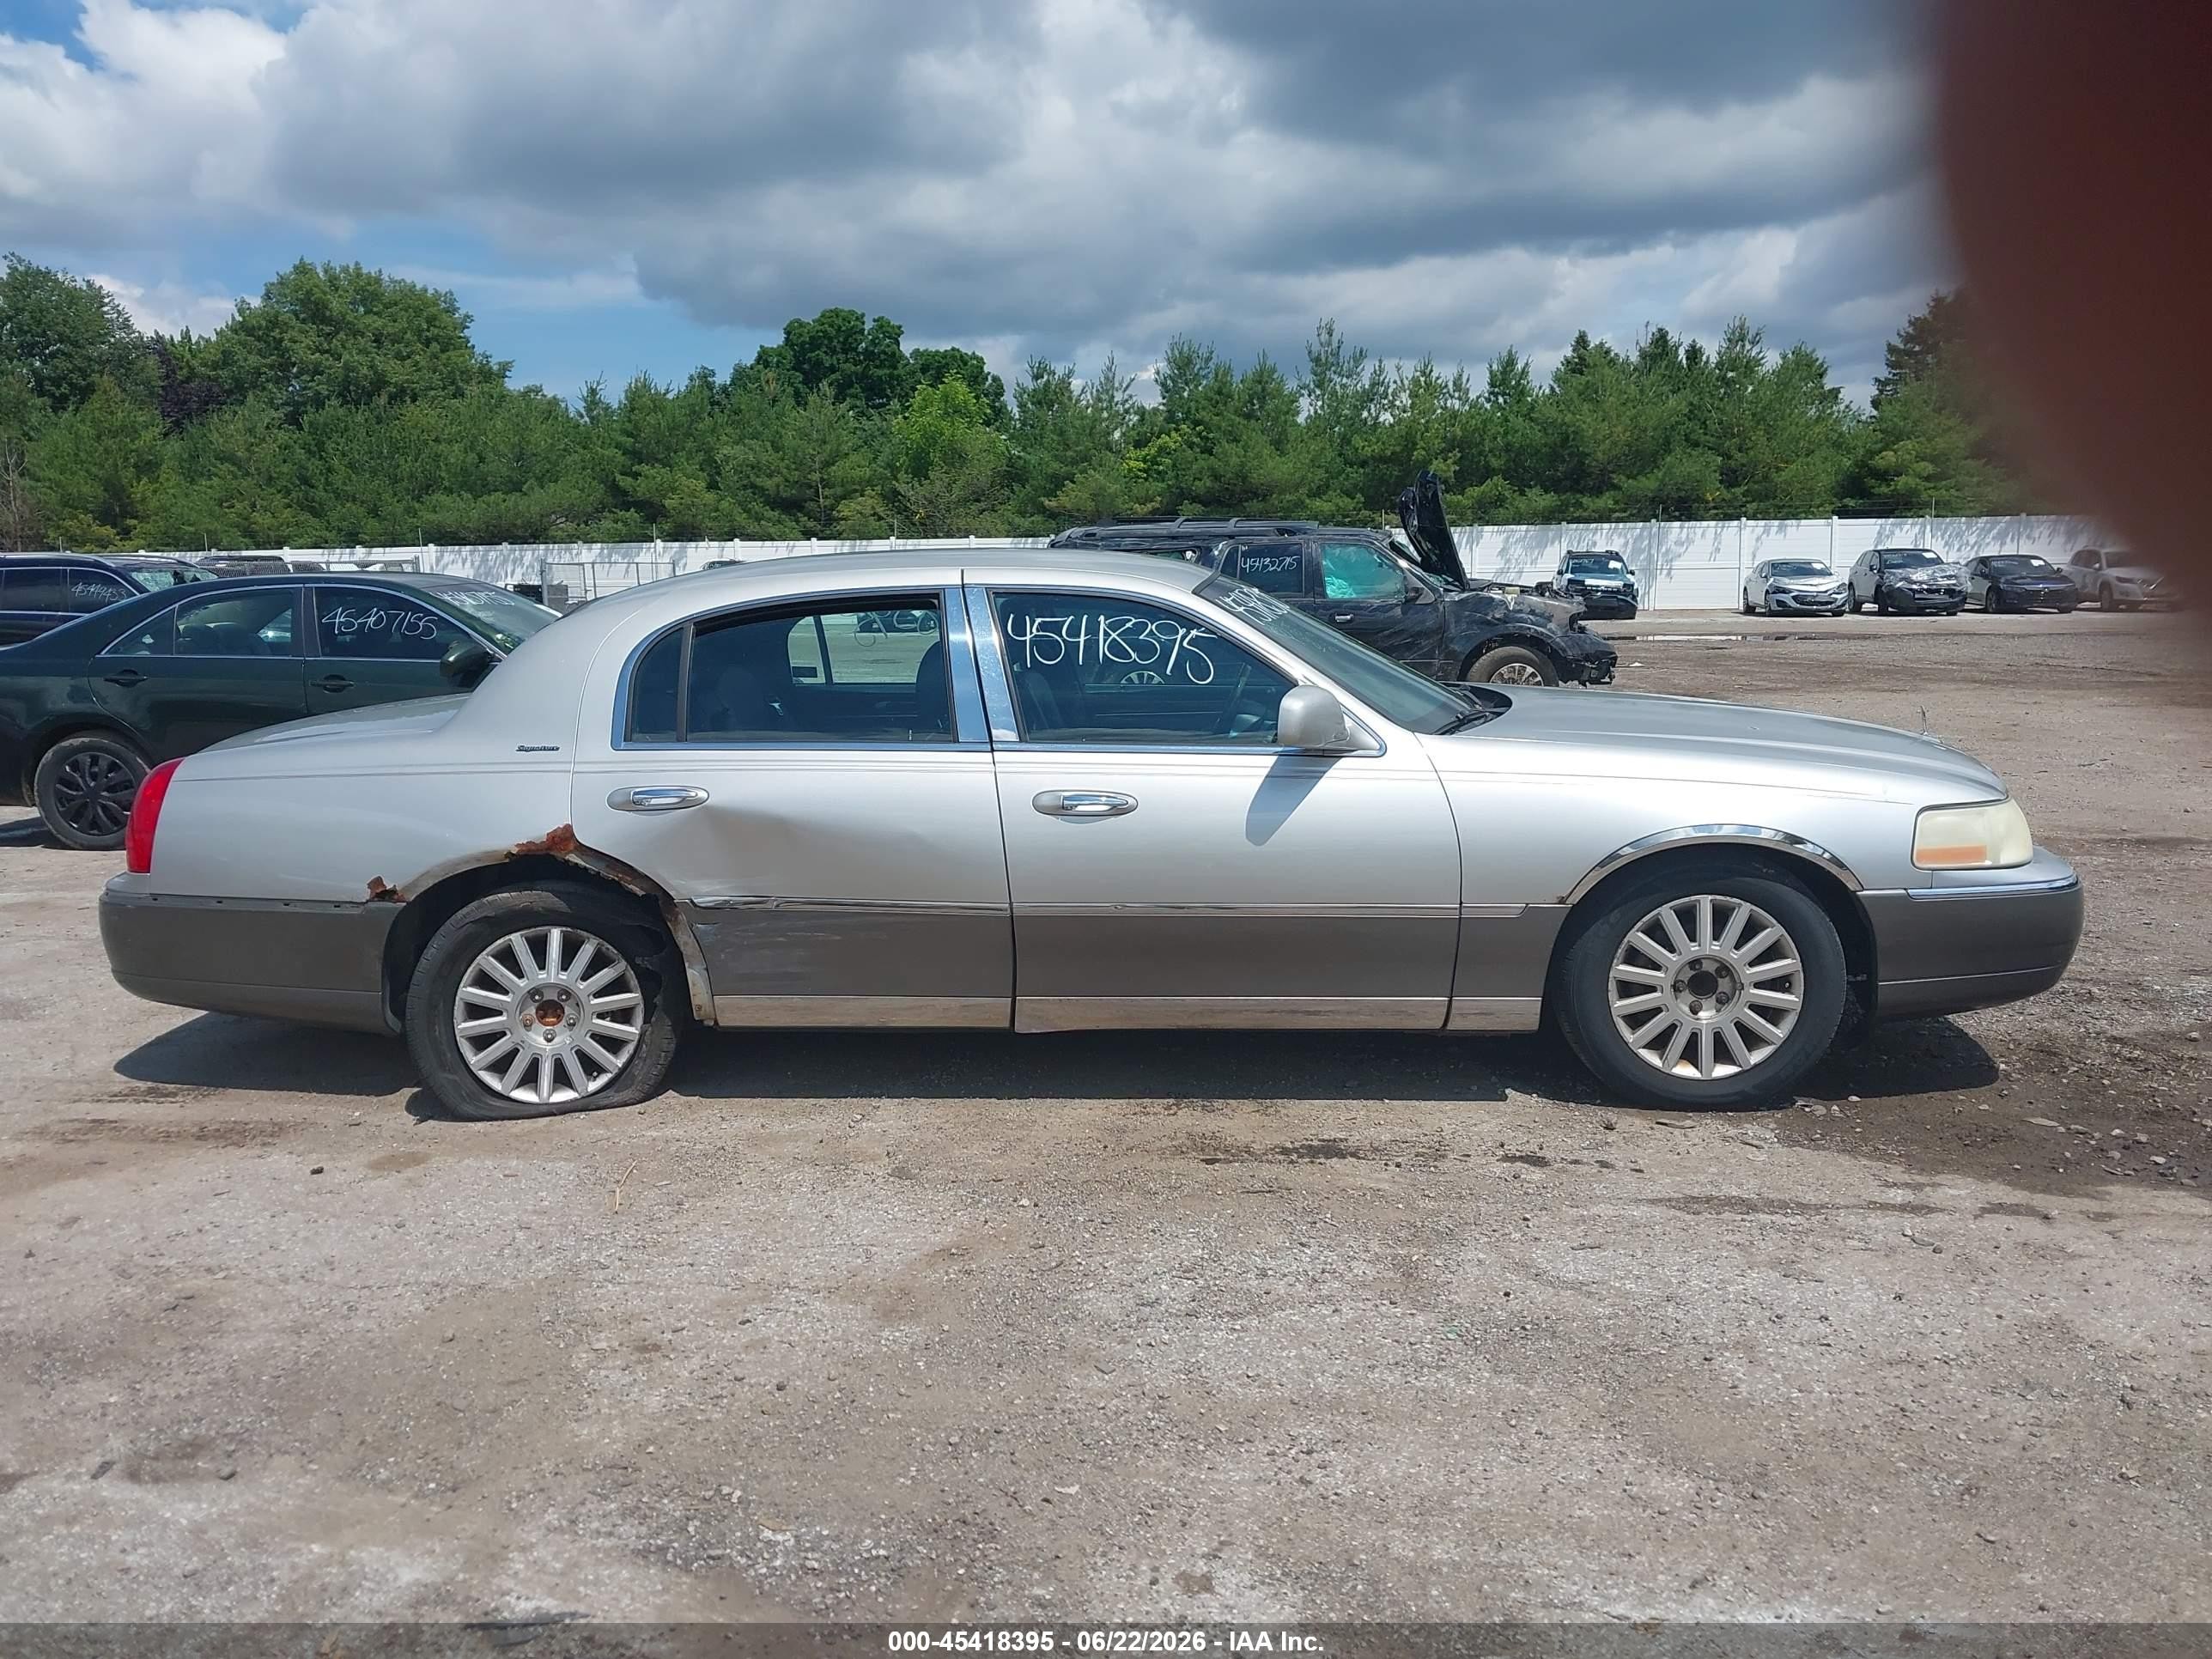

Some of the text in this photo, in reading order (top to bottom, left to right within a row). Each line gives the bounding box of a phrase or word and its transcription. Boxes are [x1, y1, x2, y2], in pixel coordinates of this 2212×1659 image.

[1241, 556, 1301, 574] 45432715
[321, 606, 439, 641] 45407155
[1006, 612, 1218, 685] 45418395
